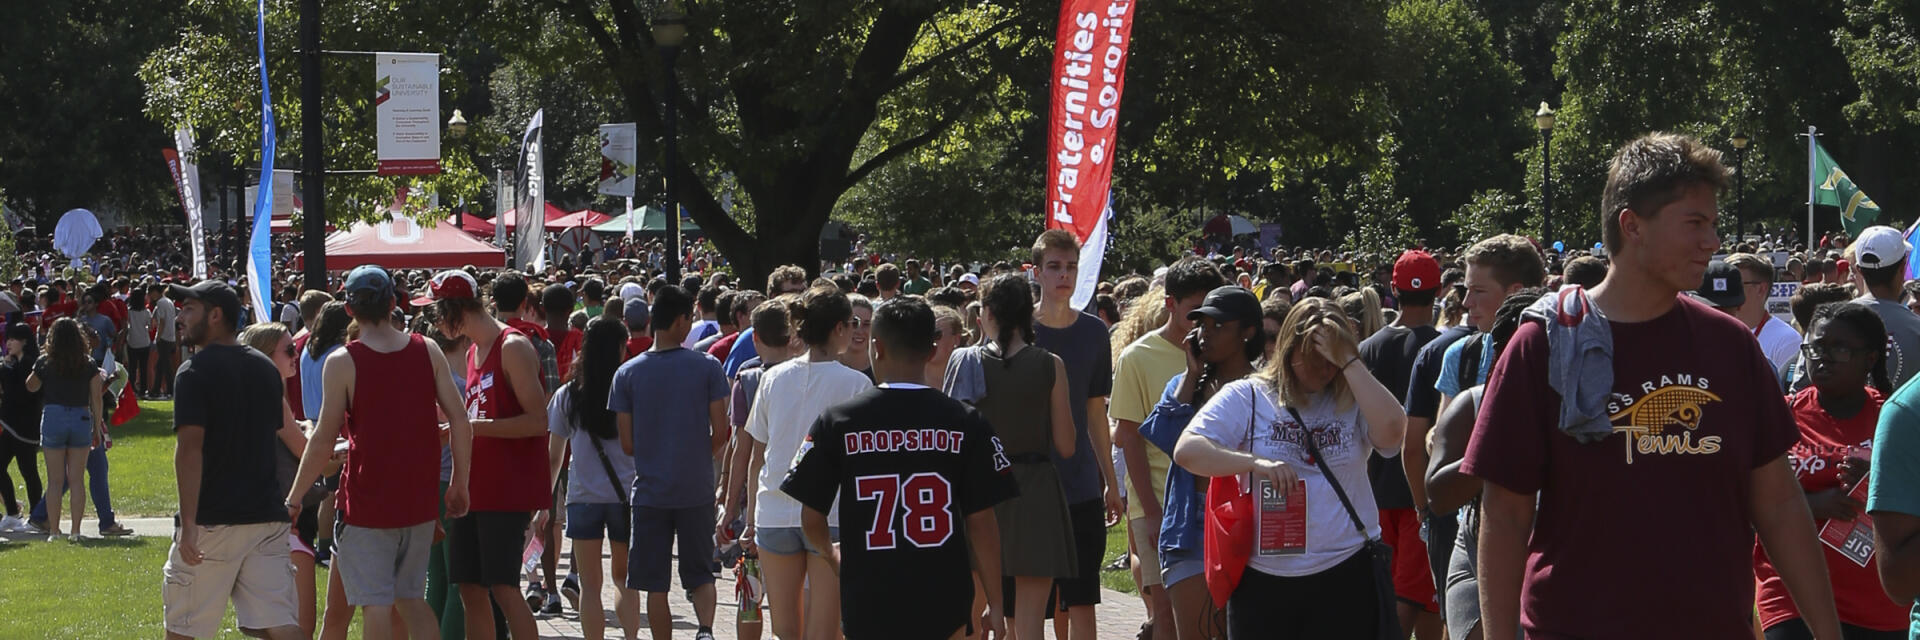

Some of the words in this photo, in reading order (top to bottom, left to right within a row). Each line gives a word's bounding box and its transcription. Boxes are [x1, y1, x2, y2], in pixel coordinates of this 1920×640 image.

[1090, 0, 1130, 128] Sororit
[1053, 11, 1098, 225] Fraternities
[526, 142, 541, 198] Service
[1607, 393, 1634, 413] SS
[1641, 373, 1710, 394] RAMS
[844, 429, 964, 455] DROPSHOT
[1612, 425, 1722, 464] Tennis
[855, 472, 953, 550] 78
[1263, 487, 1281, 499] SI
[1844, 537, 1872, 558] SIF
